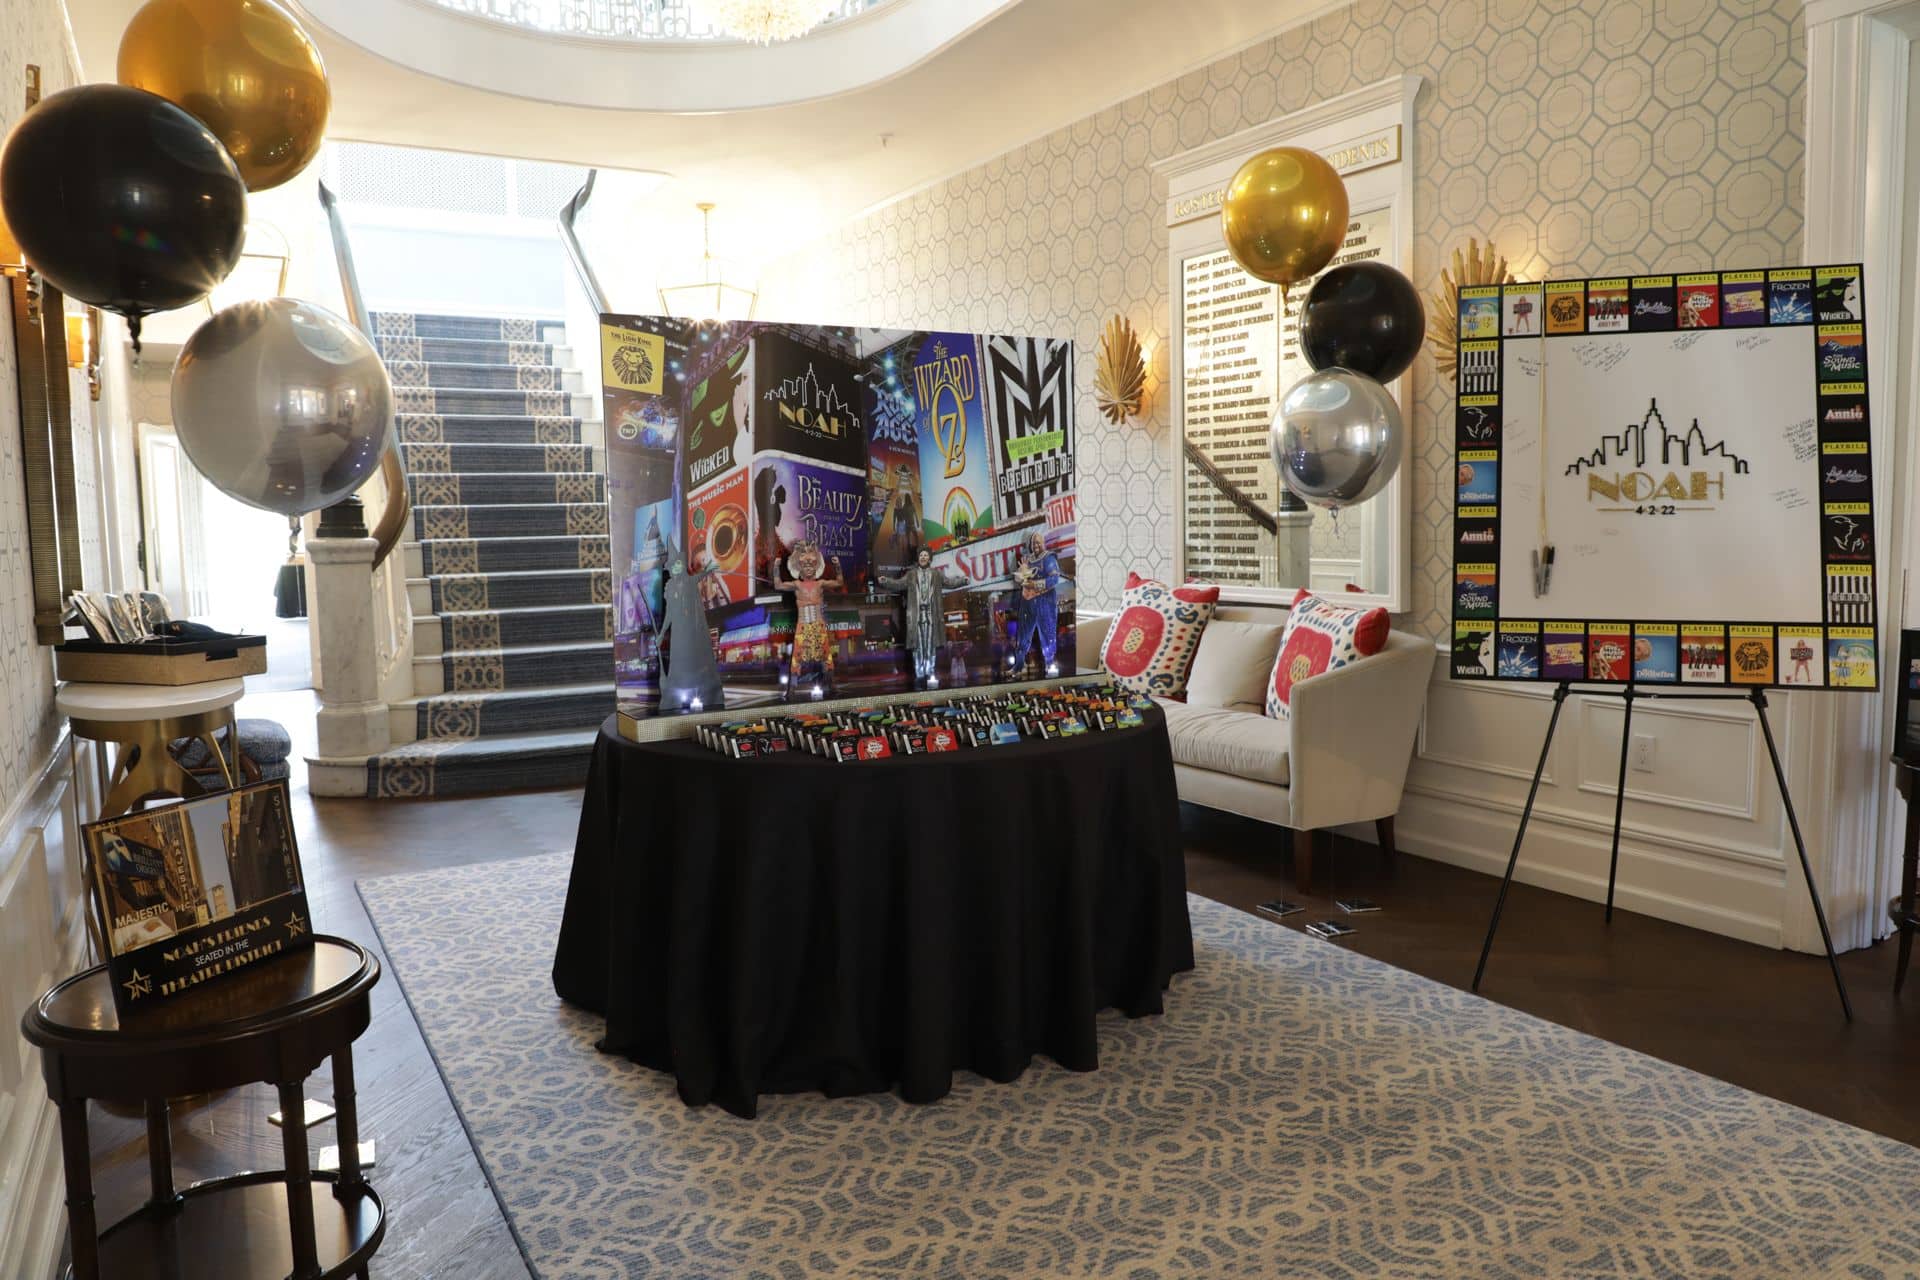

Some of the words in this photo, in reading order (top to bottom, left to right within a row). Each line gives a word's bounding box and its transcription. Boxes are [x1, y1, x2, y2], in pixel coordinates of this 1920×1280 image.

[1771, 282, 1810, 291] FROZEN
[933, 340, 948, 360] THE
[1830, 361, 1861, 372] MUSIC
[914, 354, 975, 412] WIZARD
[779, 401, 847, 438] NOAH
[1824, 408, 1863, 420] Annie
[688, 497, 701, 510] THE
[726, 473, 745, 490] MAN
[798, 475, 863, 522] BEAUTY
[1588, 471, 1724, 502] NOAH
[800, 513, 863, 547] BEAST
[1460, 530, 1494, 543] Annie
[1459, 593, 1488, 603] SOUND
[1501, 634, 1537, 643] FROZEN
[115, 902, 169, 929] MAJESTIC
[217, 916, 271, 945] FRIENDS
[195, 949, 225, 967] SEATED
[225, 944, 235, 956] IN
[235, 939, 249, 953] THE
[226, 939, 283, 971] DISTRICT
